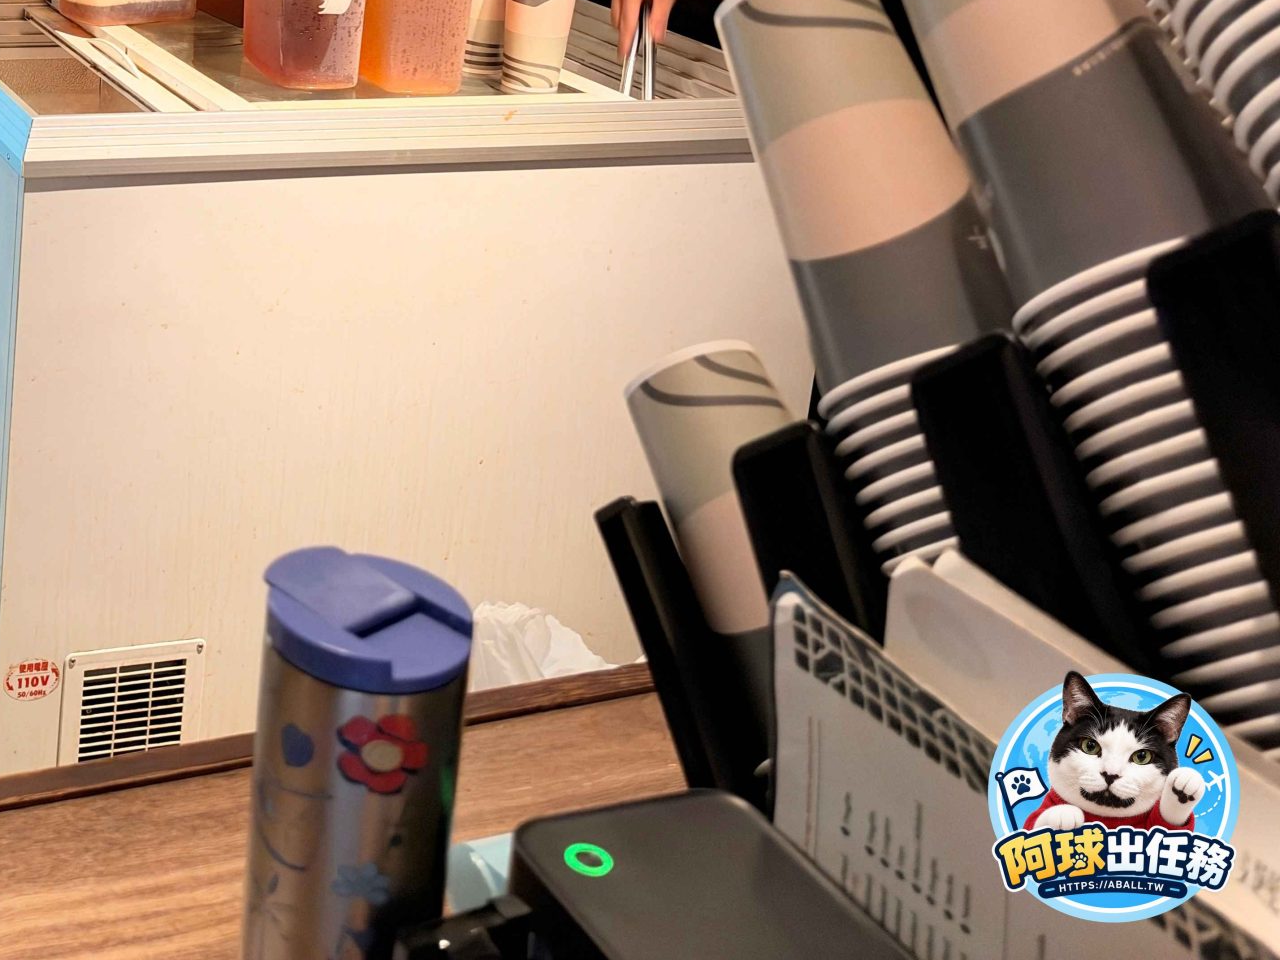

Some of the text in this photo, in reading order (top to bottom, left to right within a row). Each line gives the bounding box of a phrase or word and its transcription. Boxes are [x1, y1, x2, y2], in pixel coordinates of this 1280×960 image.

[19, 661, 49, 673] 使用電壓
[17, 675, 50, 689] 110V
[18, 689, 47, 698] 50/60Hz
